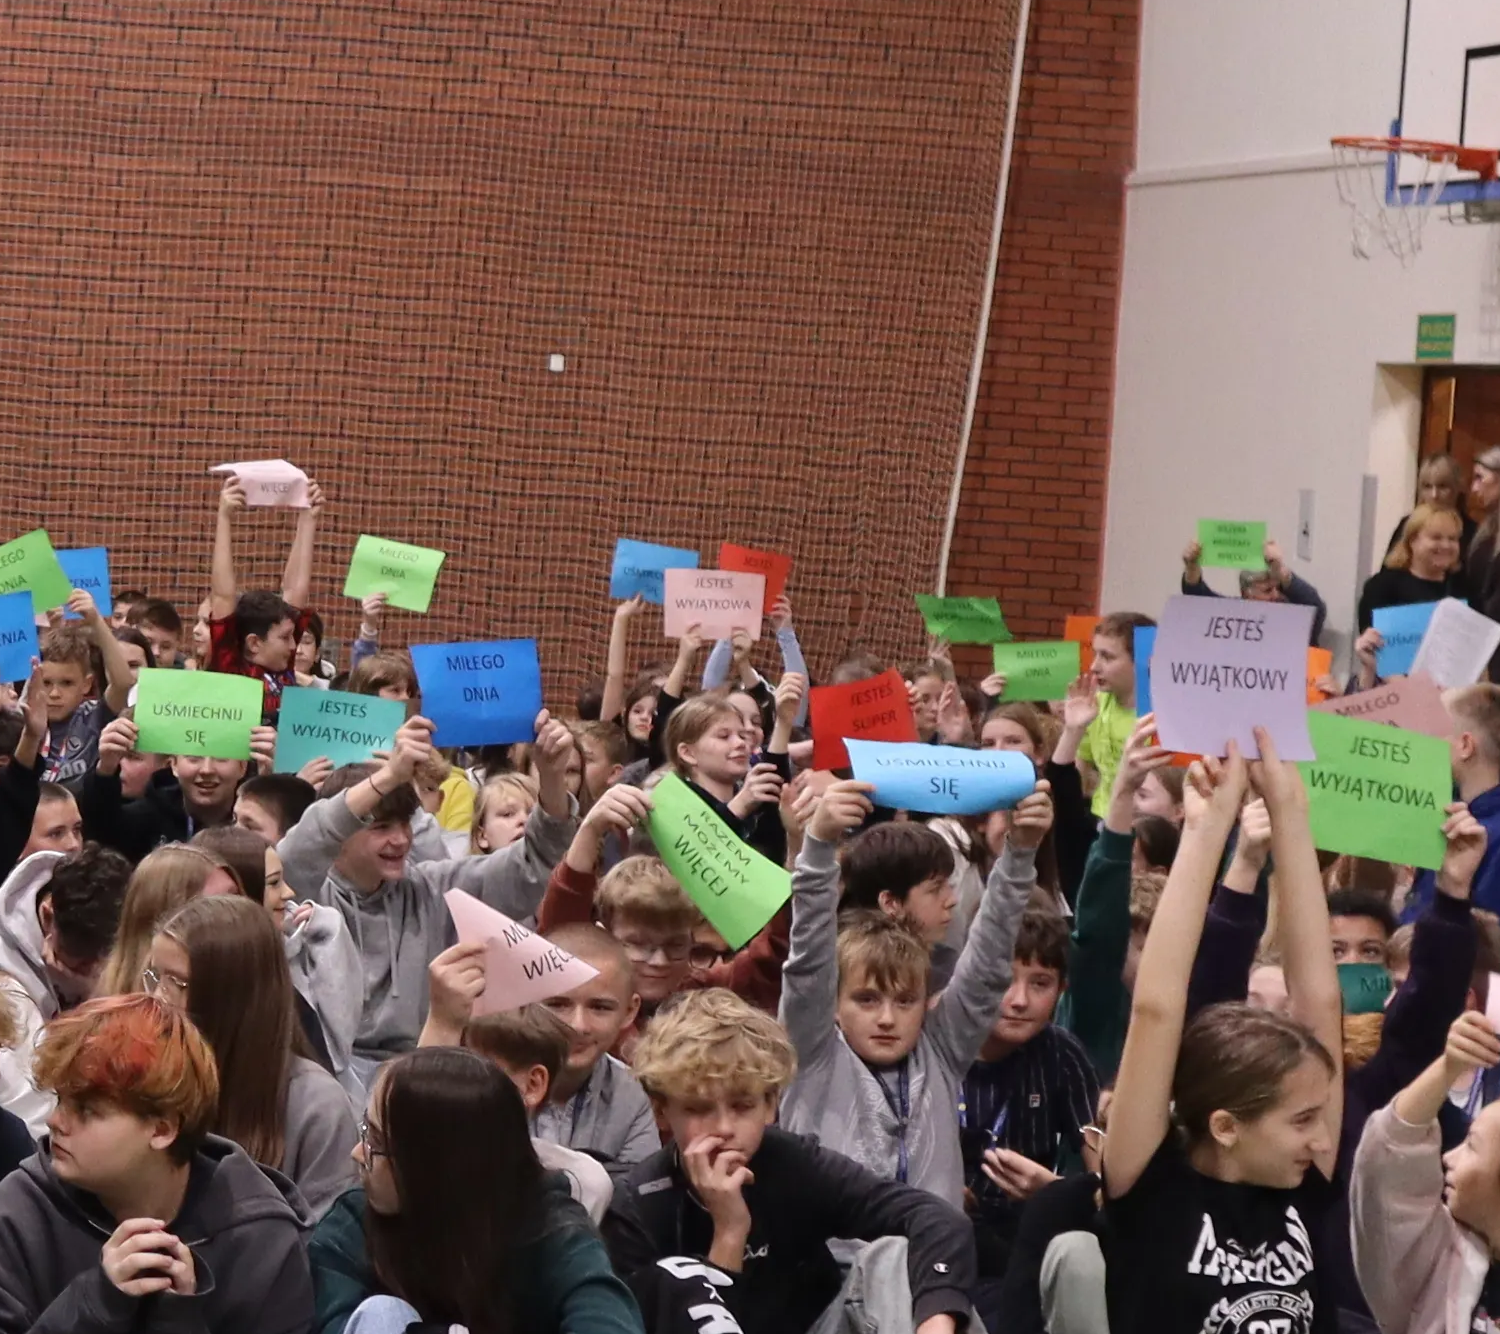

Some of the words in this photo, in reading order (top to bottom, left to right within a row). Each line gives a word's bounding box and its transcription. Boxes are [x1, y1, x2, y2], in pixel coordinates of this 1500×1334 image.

[694, 575, 734, 589] JESTEŚ
[675, 596, 752, 613] WYJĄTKOWA
[1204, 615, 1266, 643] JESTEŚ
[446, 653, 506, 672] MIŁEGO
[1170, 661, 1289, 693] WYJĄTKOWY
[463, 685, 500, 703] DNIA
[1334, 691, 1401, 719] MIŁEGO
[152, 701, 244, 722] UŚMIECHNIJ
[317, 699, 368, 719] JESTEŚ
[184, 728, 206, 746] SIĘ
[292, 722, 387, 749] WYJĄTKOWY
[1349, 734, 1412, 766] JESTEŚ
[929, 776, 961, 801] SIĘ
[1309, 769, 1437, 812] WYJĄTKOWA
[700, 810, 752, 866] RAZEM
[673, 834, 729, 898] WIĘCEJ
[522, 943, 576, 982] WIĘC
